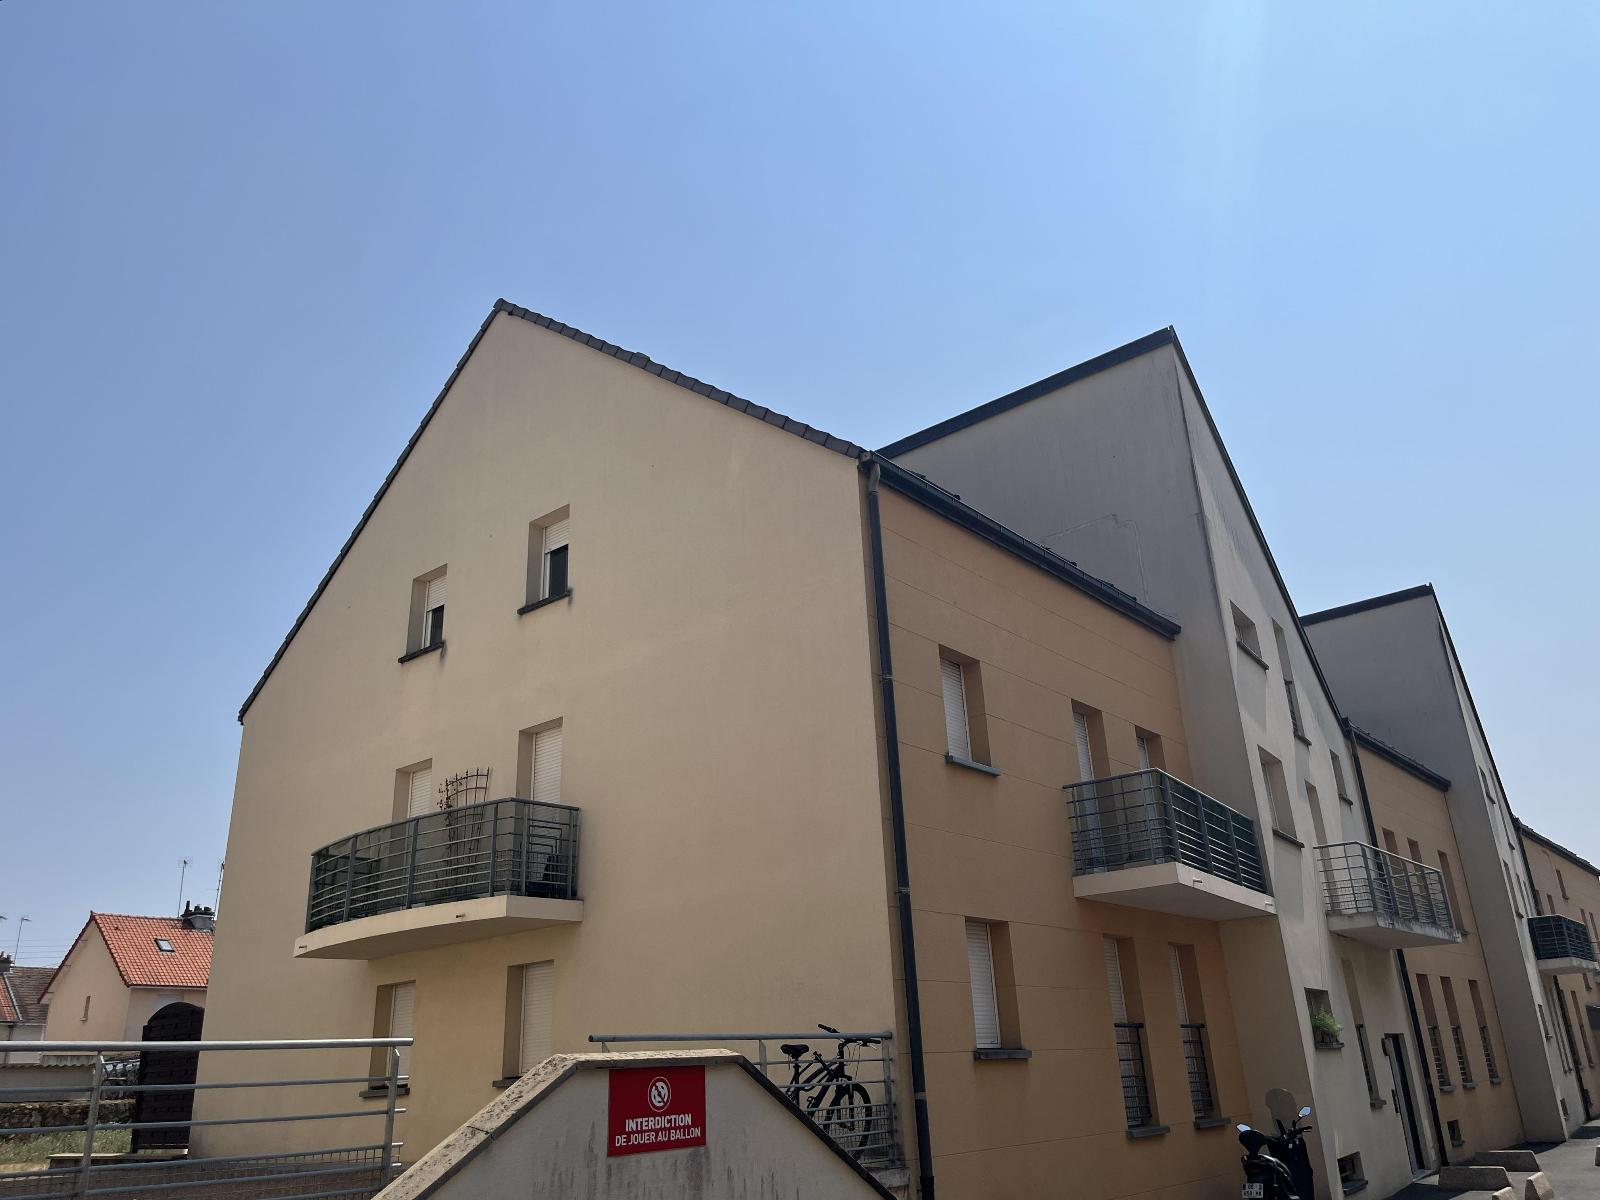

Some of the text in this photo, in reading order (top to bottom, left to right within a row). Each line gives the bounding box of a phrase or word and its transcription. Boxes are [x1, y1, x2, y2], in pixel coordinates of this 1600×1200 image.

[625, 1113, 692, 1132] INTERDICTION
[615, 1127, 701, 1147] DE JOUER AU BALLON
